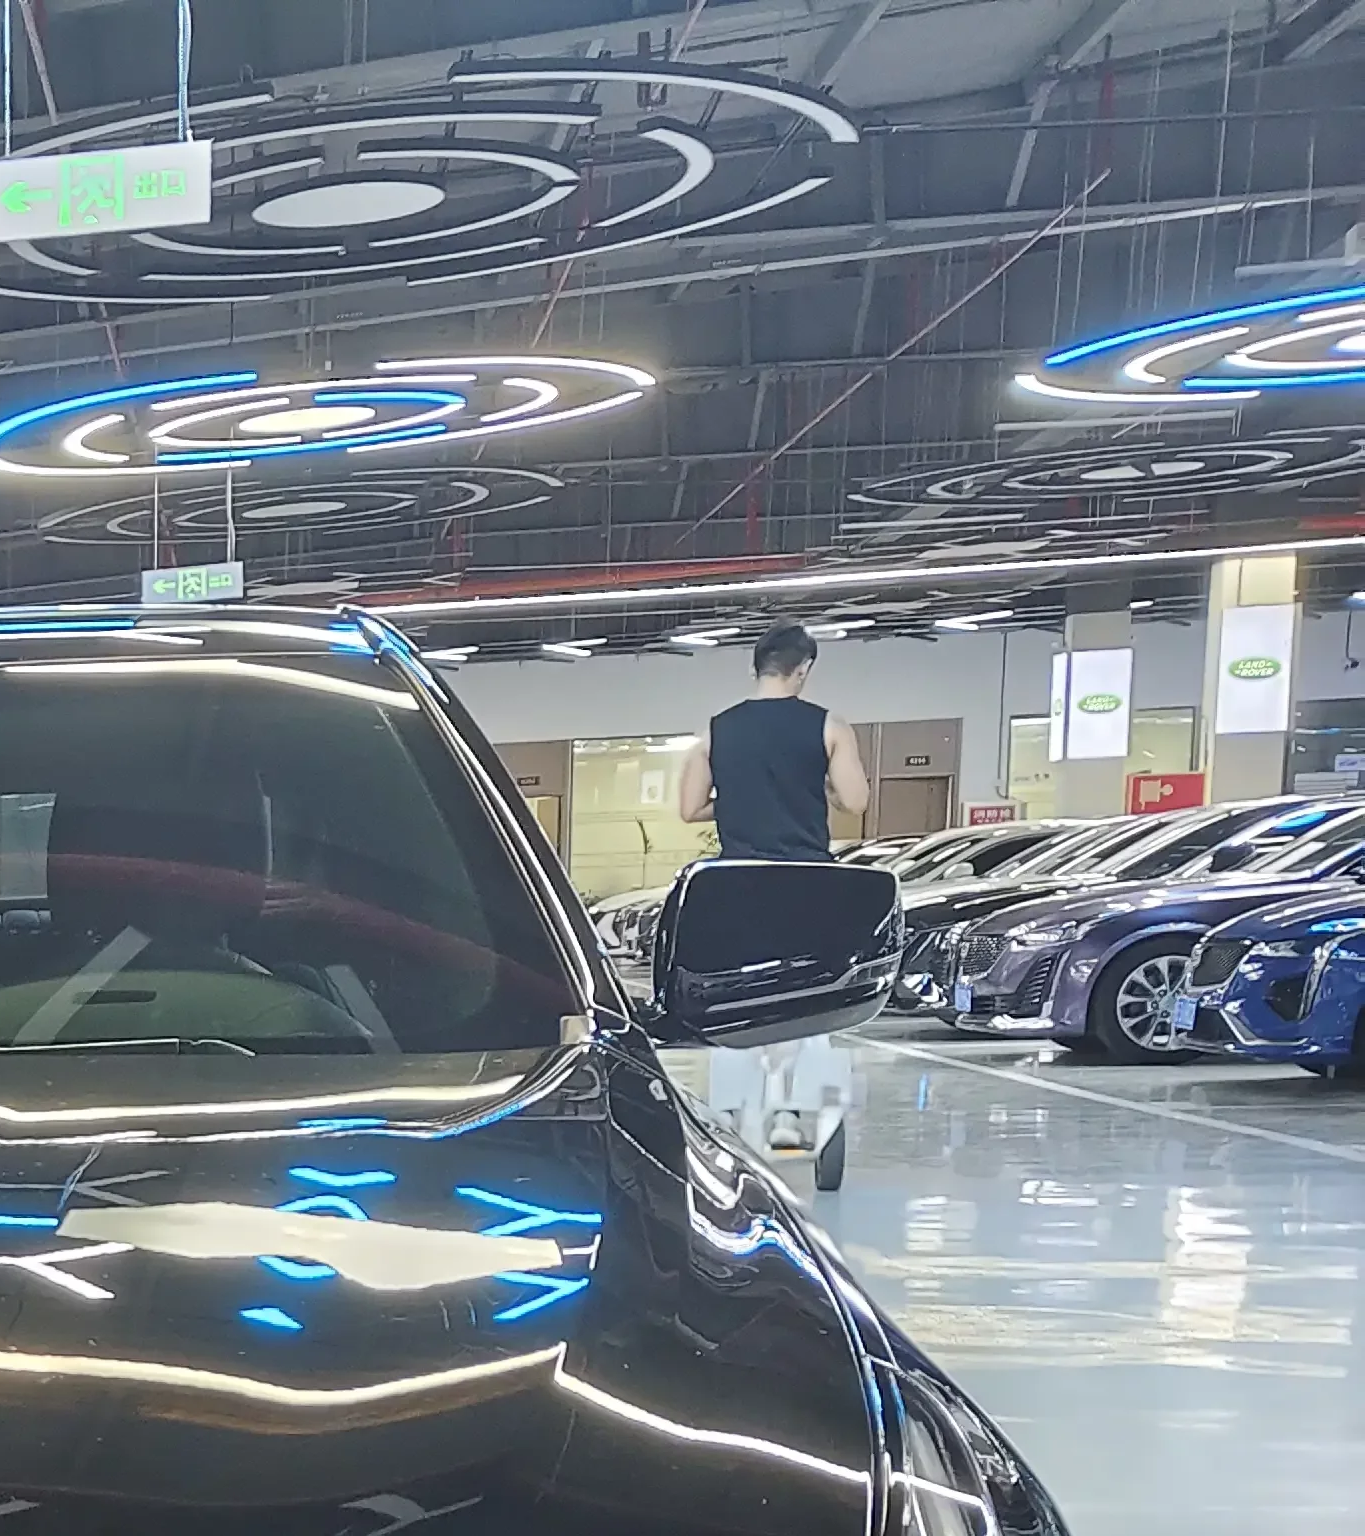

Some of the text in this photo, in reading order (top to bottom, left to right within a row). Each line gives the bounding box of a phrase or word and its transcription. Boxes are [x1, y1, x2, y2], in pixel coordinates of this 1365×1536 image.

[134, 170, 186, 198] 出口
[1238, 659, 1266, 669] LAND
[1240, 667, 1275, 677] ROVER
